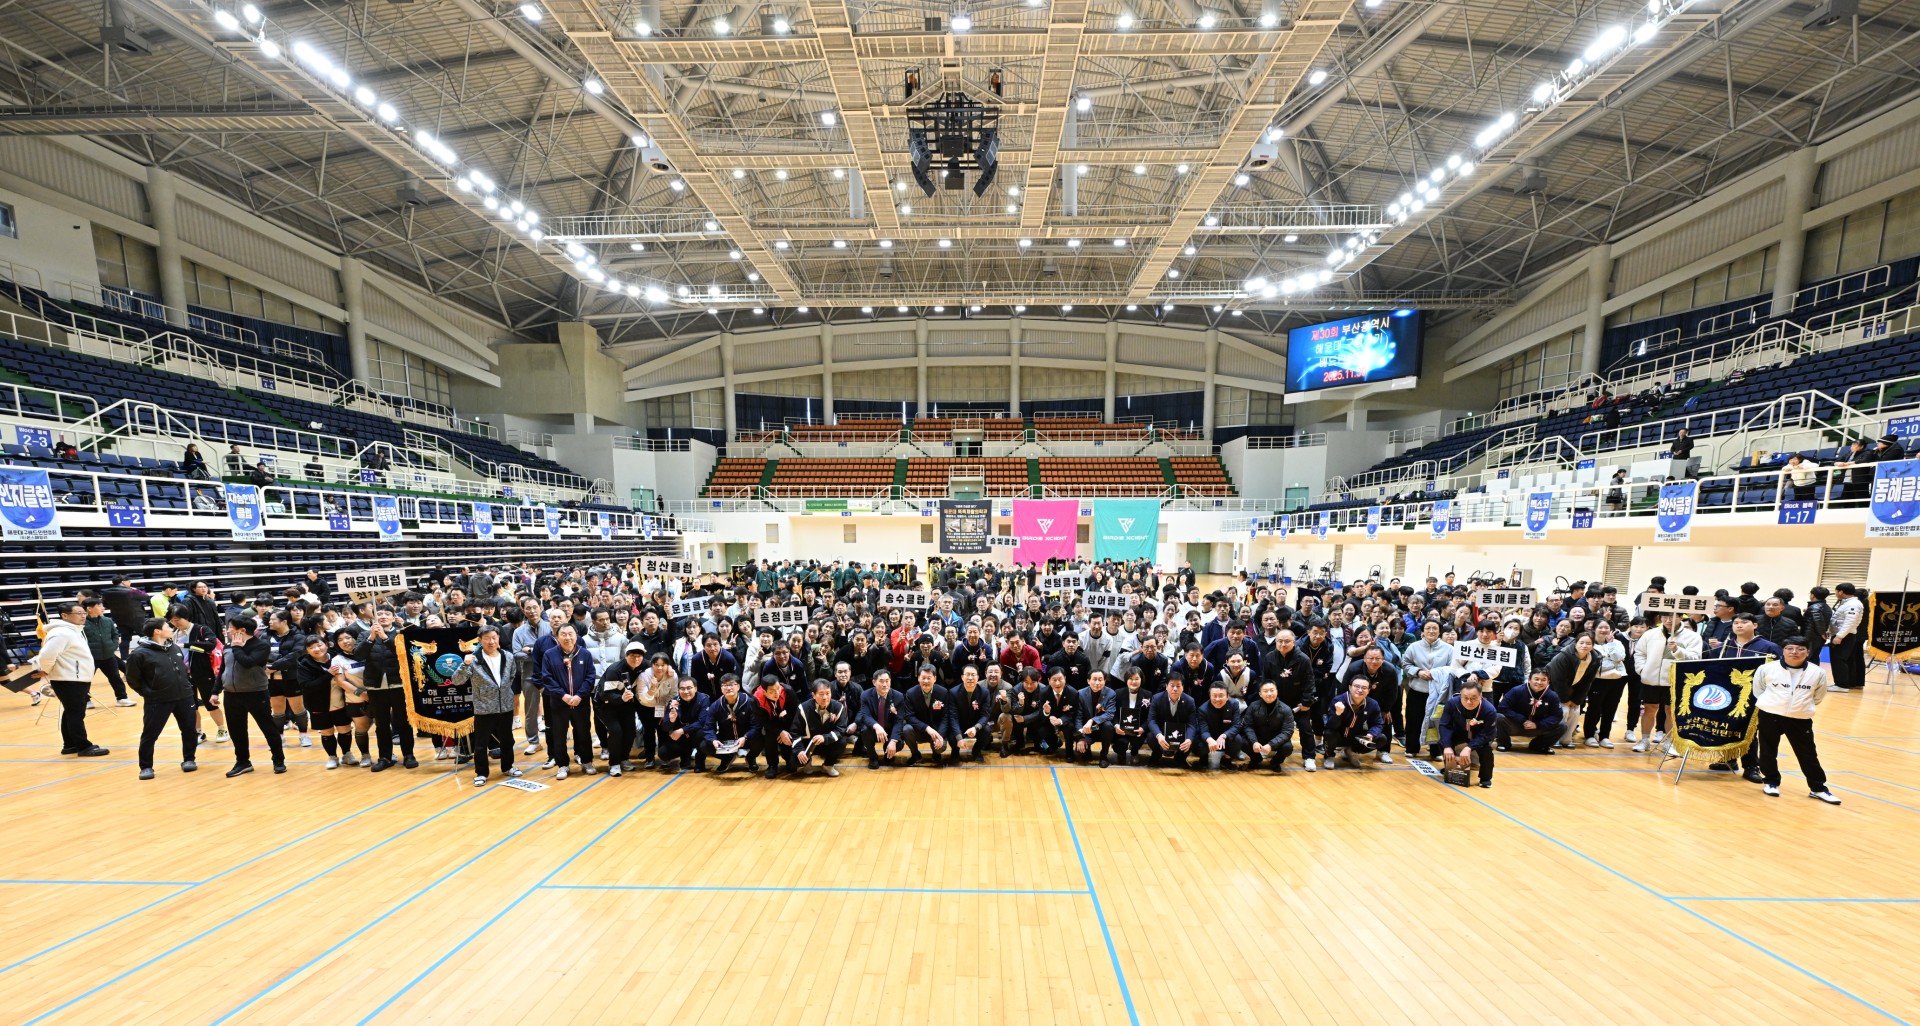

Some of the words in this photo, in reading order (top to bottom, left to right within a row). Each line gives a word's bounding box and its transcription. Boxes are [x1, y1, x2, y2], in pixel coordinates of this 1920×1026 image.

[1311, 326, 1339, 341] 제30회
[1315, 341, 1342, 354] 해운대
[1890, 424, 1919, 436] 2-10
[23, 434, 48, 448] 2-3
[363, 474, 374, 482] 2-4
[1659, 496, 1693, 516] 반산클럽
[114, 513, 141, 524] 1-2
[236, 507, 253, 519] 클럽
[1530, 510, 1545, 522] 클럽
[1785, 510, 1810, 523] 1-17
[332, 519, 348, 529] 1-3
[463, 524, 474, 532] 1-4
[1576, 518, 1589, 528] 1-16
[646, 560, 693, 574] 청산클럽
[344, 574, 401, 589] 해운대클럽
[1043, 577, 1081, 588] 센텀클럽
[885, 593, 926, 605] 송수클럽
[1087, 595, 1126, 606] 상어클럽
[1482, 593, 1531, 604] 동해클럽
[1648, 597, 1707, 611] 동백클럽
[760, 610, 803, 622] 송정클럽
[1460, 645, 1511, 663] 반산클럽
[422, 694, 473, 705] 배드민턴클
